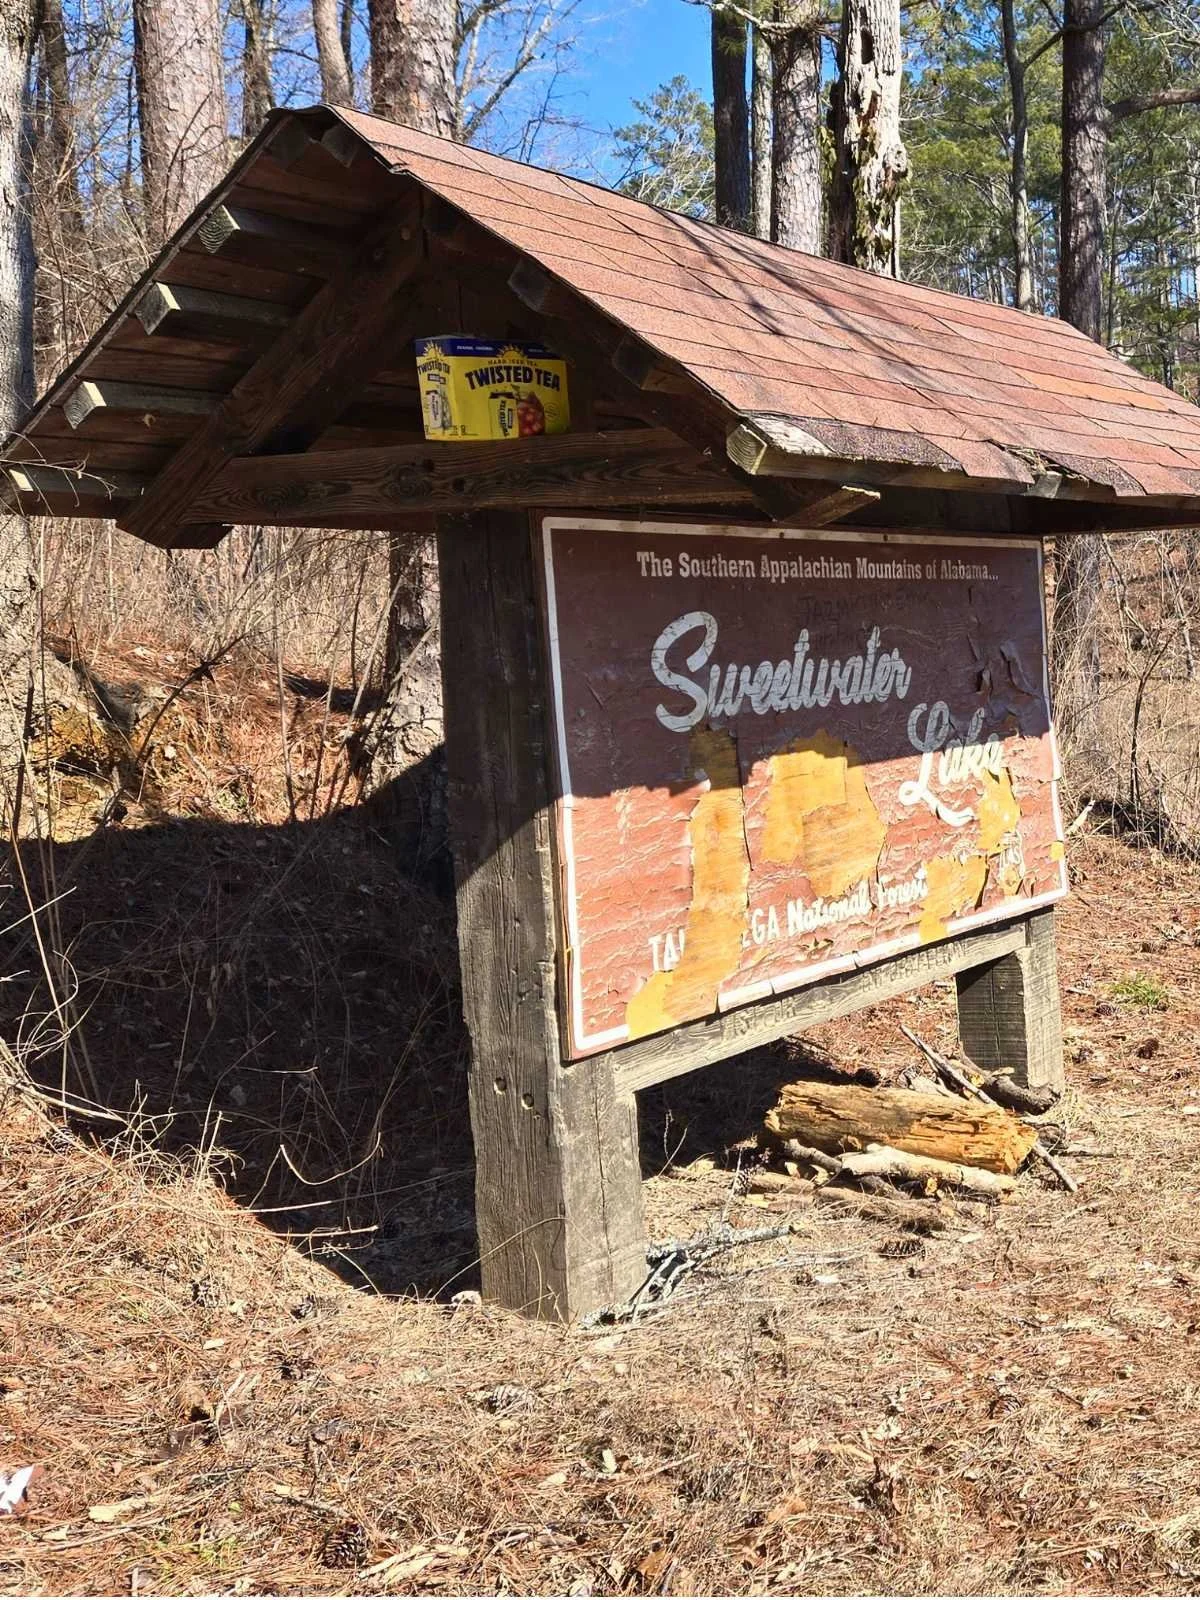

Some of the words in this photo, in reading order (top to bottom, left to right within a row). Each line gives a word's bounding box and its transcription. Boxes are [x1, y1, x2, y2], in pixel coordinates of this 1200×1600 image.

[465, 365, 533, 390] TWISTED
[534, 368, 561, 392] TEA
[636, 551, 673, 578] The
[679, 552, 756, 578] Southern
[760, 555, 851, 584] Appalachian
[856, 557, 923, 580] Mountains
[926, 559, 937, 580] of
[940, 559, 999, 581] Alabama...
[651, 610, 912, 732] Sweetwater
[898, 700, 1003, 827] Lake
[786, 880, 872, 936] National
[876, 868, 929, 908] Forest
